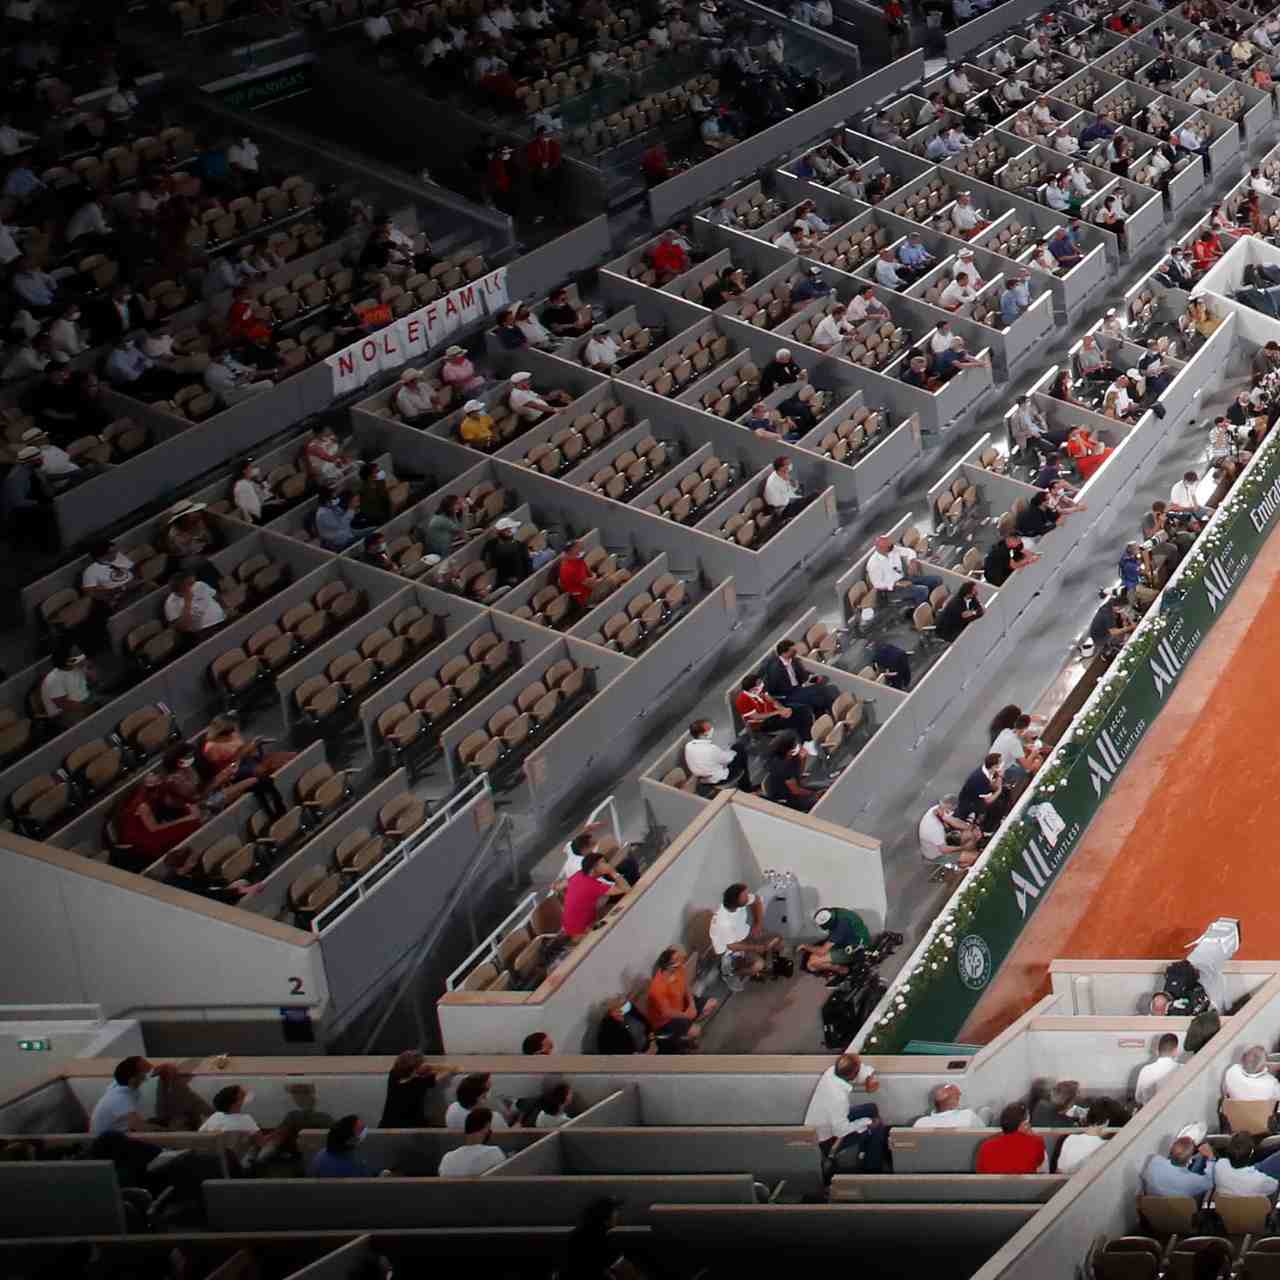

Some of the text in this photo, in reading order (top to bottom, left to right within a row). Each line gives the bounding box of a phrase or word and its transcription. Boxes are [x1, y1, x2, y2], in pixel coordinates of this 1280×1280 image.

[1108, 705, 1128, 735] ACCOR
[1114, 726, 1128, 746] LIVE
[1120, 718, 1146, 759] LIMITLESS
[1050, 822, 1081, 870] LIMITLESS
[287, 977, 305, 995] 2
